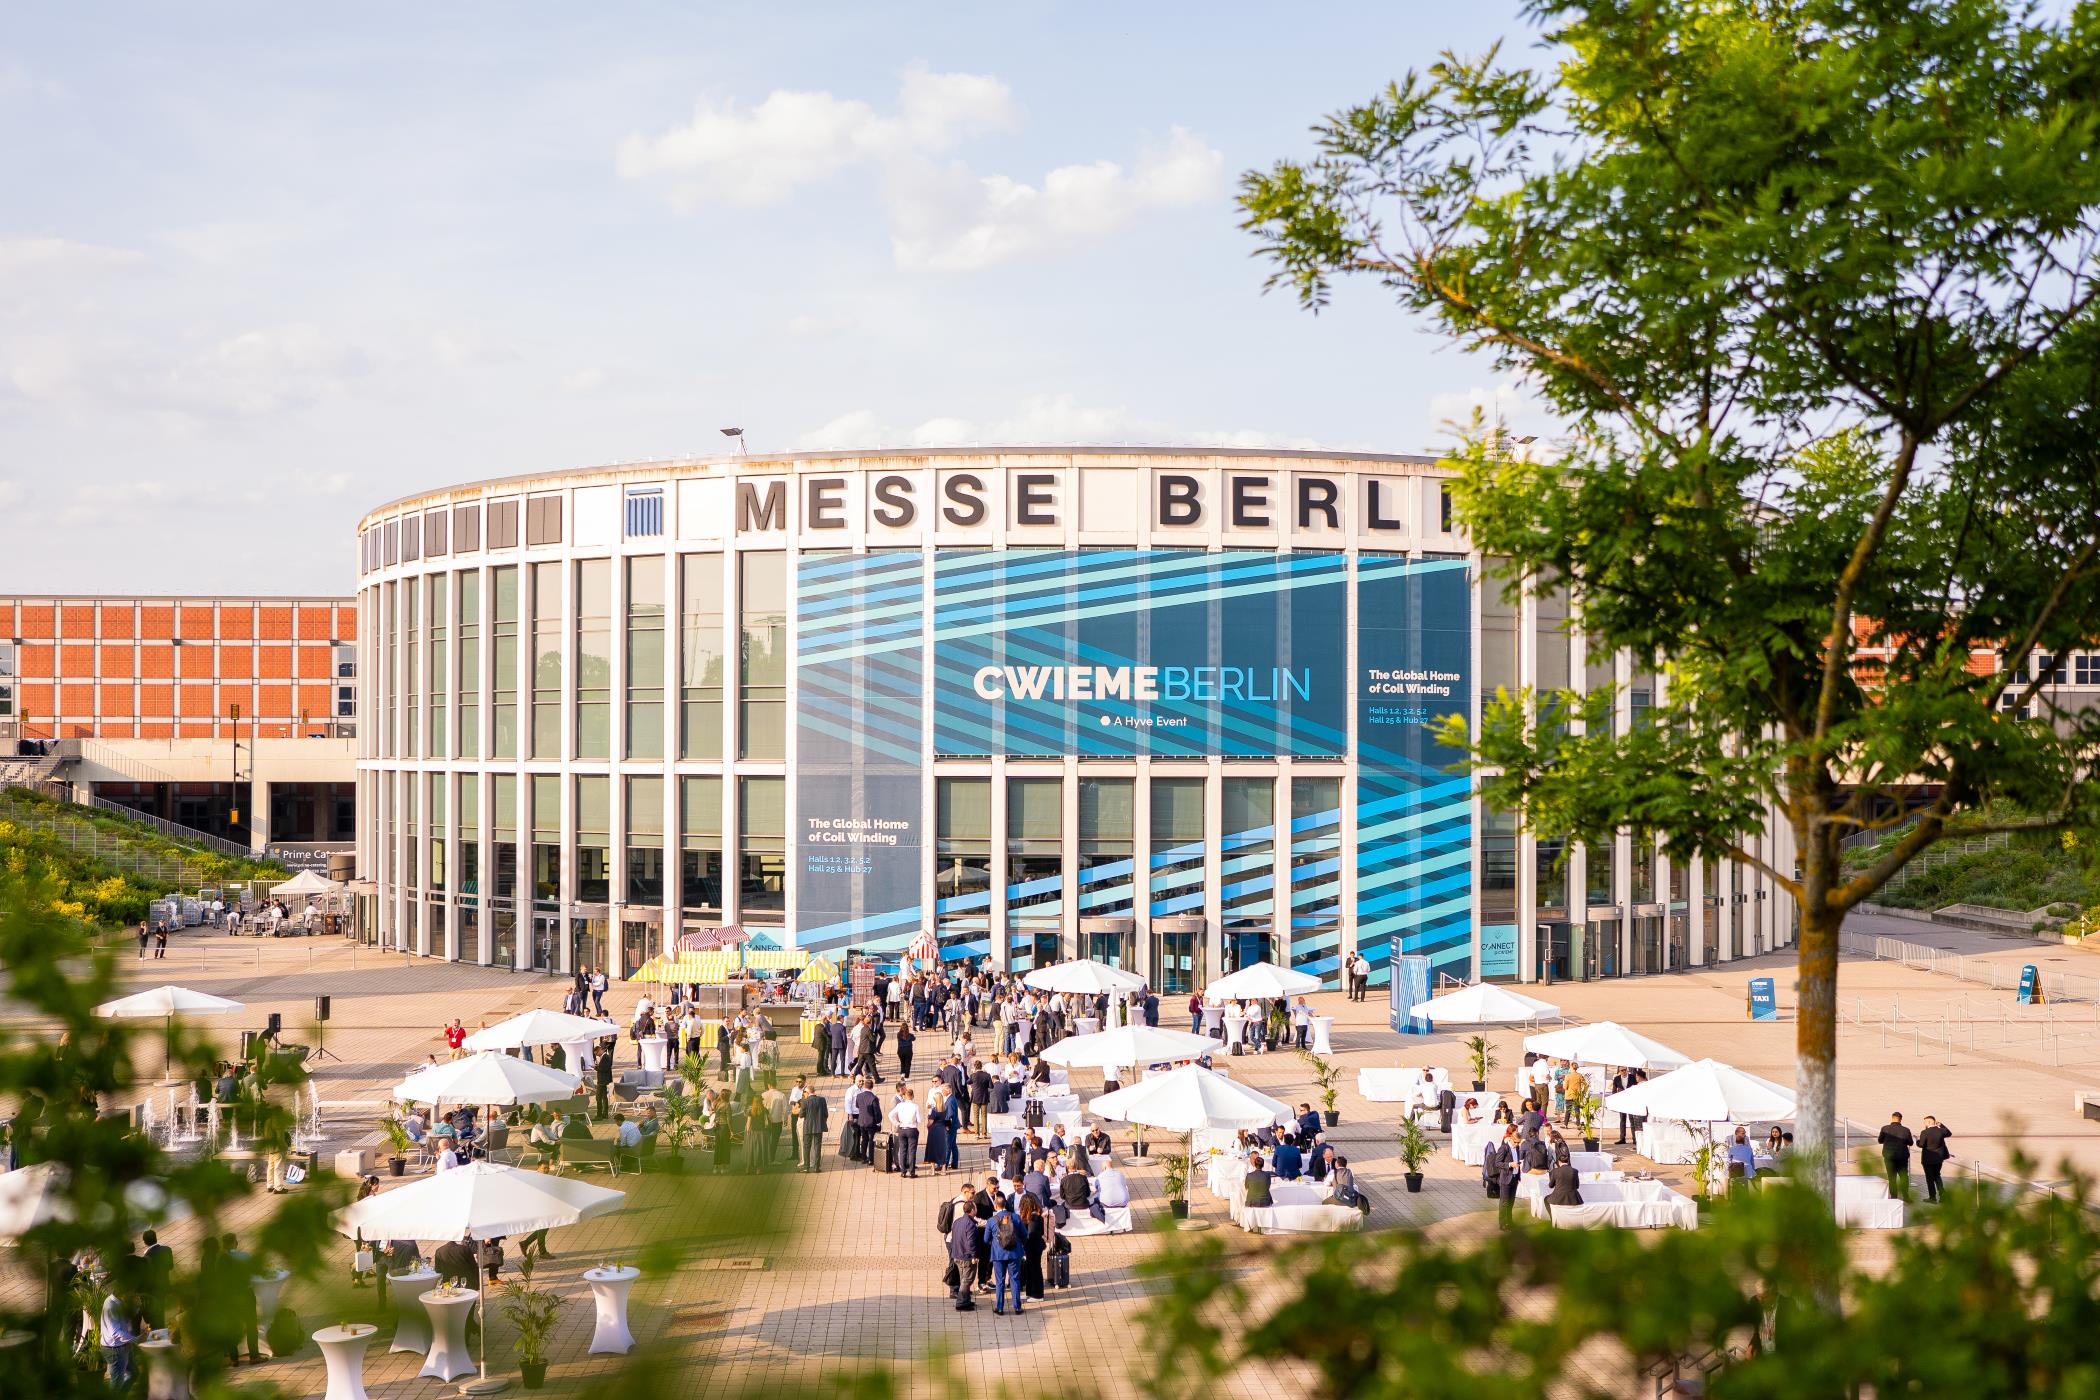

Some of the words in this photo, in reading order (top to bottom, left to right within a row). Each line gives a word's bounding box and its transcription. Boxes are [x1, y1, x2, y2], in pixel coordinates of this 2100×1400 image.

[737, 474, 1055, 531] MESSE
[1160, 475, 1452, 533] BERLI
[1369, 670, 1390, 680] The
[1392, 670, 1428, 680] Global
[1430, 671, 1460, 681] Home
[973, 666, 1159, 700] CWIEME
[1164, 667, 1310, 701] BERLIN
[1369, 683, 1381, 693] of
[1382, 683, 1404, 693] Coil
[1406, 684, 1450, 696] Winding
[1369, 707, 1388, 715] Halls
[1114, 717, 1123, 727] A
[1125, 716, 1154, 729] Hyve
[1156, 716, 1187, 727] Event
[1420, 718, 1429, 726] 27
[808, 819, 831, 829] The
[833, 819, 872, 829] Global
[874, 819, 909, 830] Home
[808, 832, 821, 842] of
[823, 832, 846, 842] Coil
[847, 832, 897, 845] Winding
[283, 850, 311, 859] Prime
[808, 855, 828, 863] Halls
[859, 857, 871, 865] 5.2
[808, 865, 824, 873] Hall
[826, 866, 835, 874] 25
[837, 865, 843, 873] &
[844, 865, 860, 873] Hub
[863, 867, 872, 875] 27
[1480, 942, 1515, 951] CONNECT
